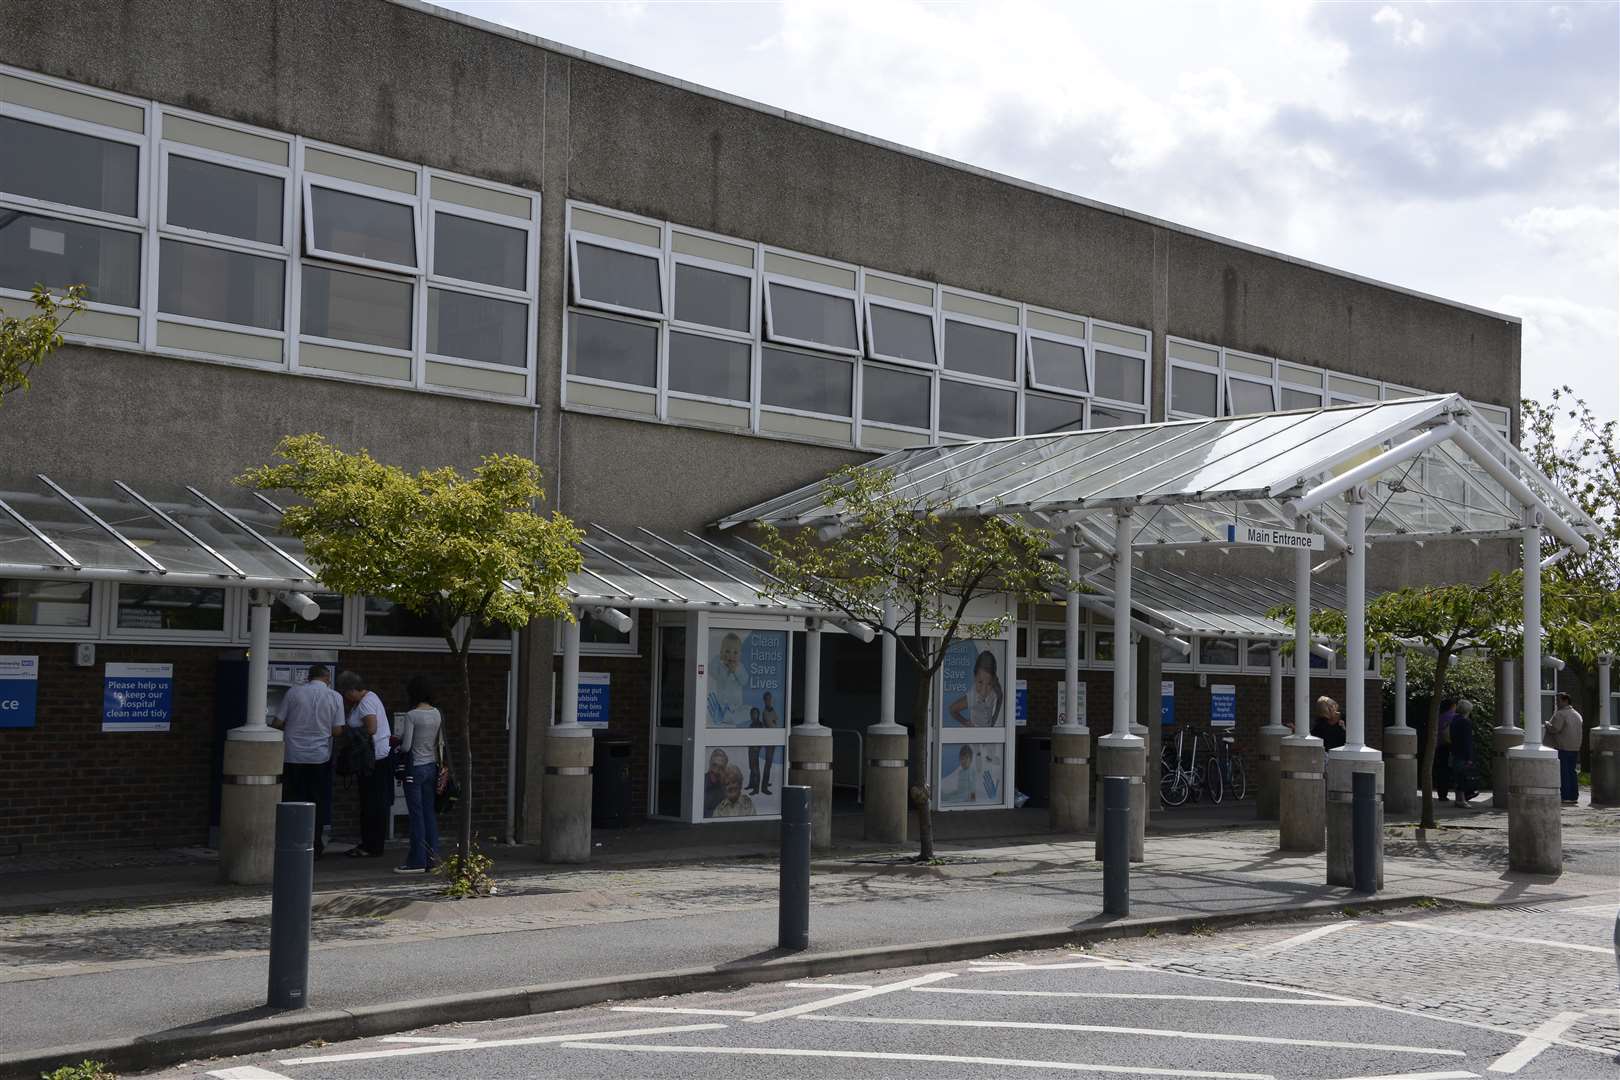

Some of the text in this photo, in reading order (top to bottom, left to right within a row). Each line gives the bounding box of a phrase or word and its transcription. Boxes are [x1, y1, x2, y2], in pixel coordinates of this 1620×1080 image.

[1248, 528, 1312, 547] Main Entrance
[751, 632, 779, 647] Clean
[751, 647, 783, 661] Hands
[750, 662, 777, 674] Save
[108, 681, 136, 689] Please
[138, 681, 157, 690] help
[750, 676, 778, 689] Lives
[113, 691, 123, 699] to
[126, 690, 146, 700] keep
[120, 700, 156, 709] Hospital
[106, 709, 168, 719] clean and tidy
